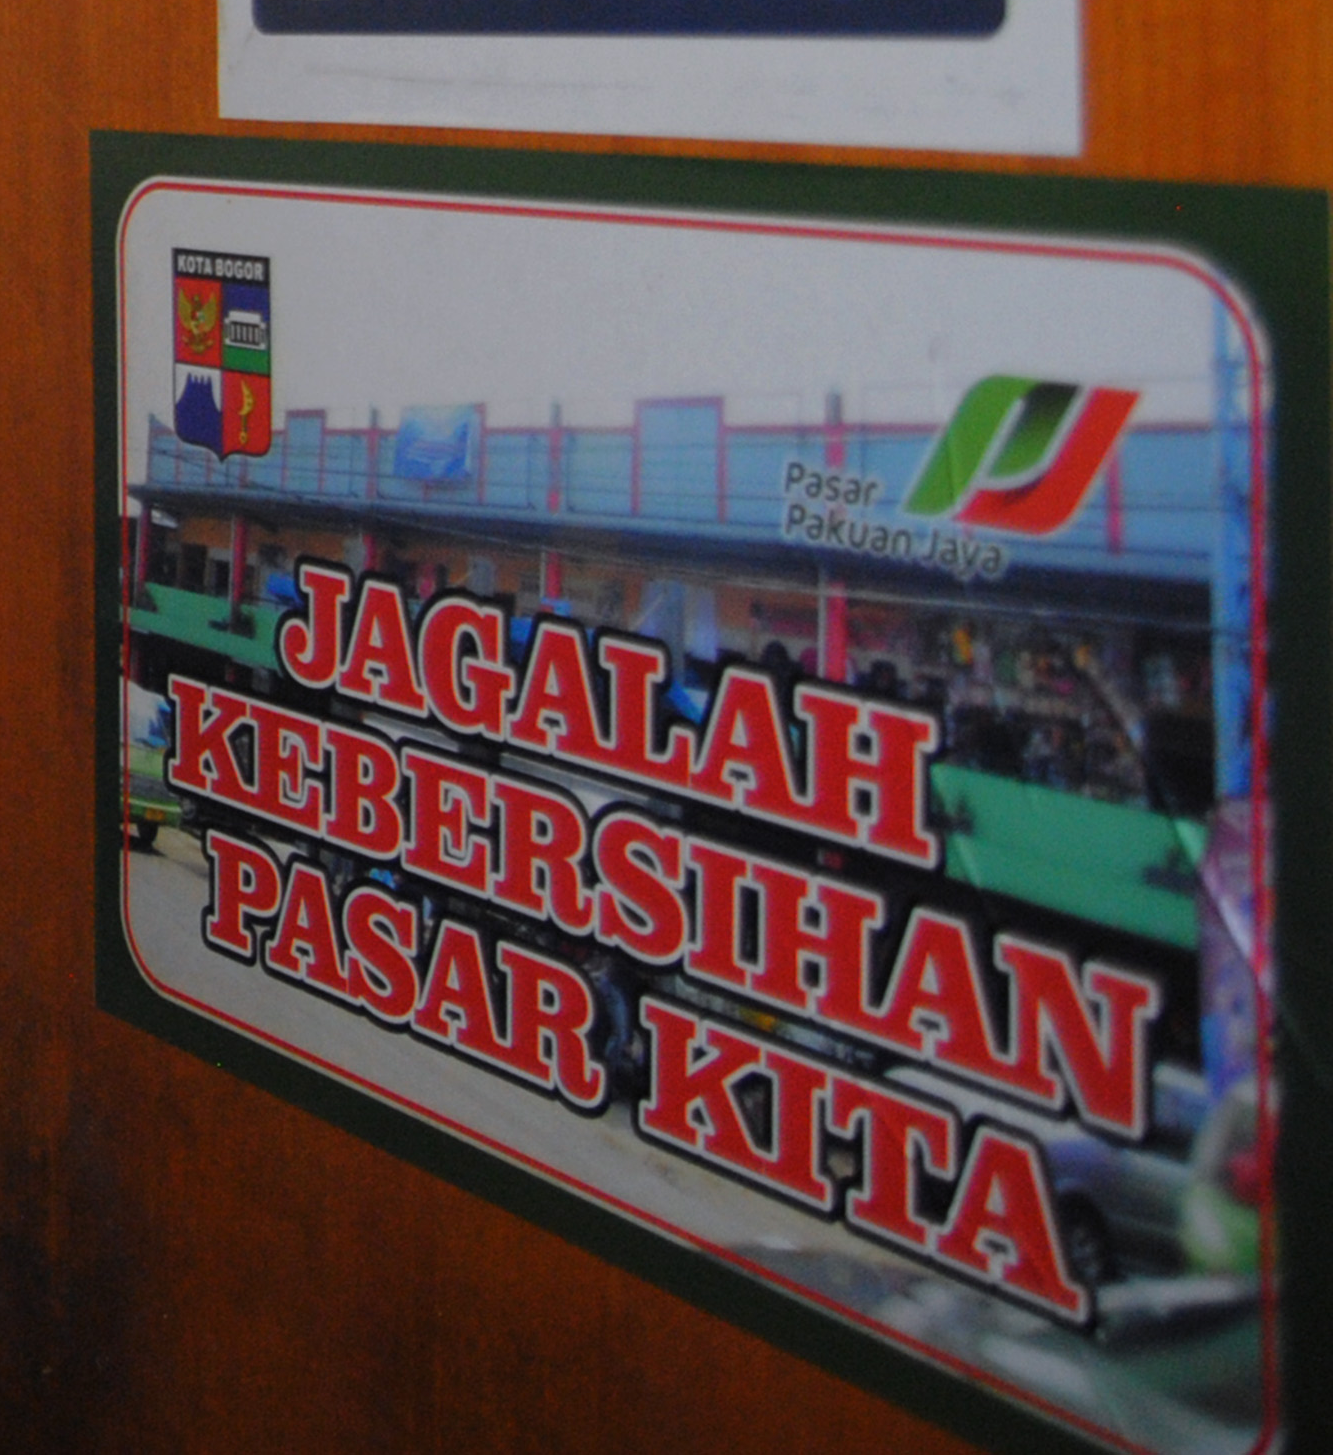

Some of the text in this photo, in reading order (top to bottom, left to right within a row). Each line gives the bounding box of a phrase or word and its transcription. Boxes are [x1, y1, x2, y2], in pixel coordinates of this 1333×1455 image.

[177, 254, 264, 281] KOTA BOGOR
[784, 462, 878, 508] Pasar
[785, 503, 1002, 577] Pakuan Jaya
[280, 565, 941, 866] JAGALAH
[166, 675, 1156, 1138] KEBERSIHAN
[206, 829, 1089, 1322] PASAR KITA
